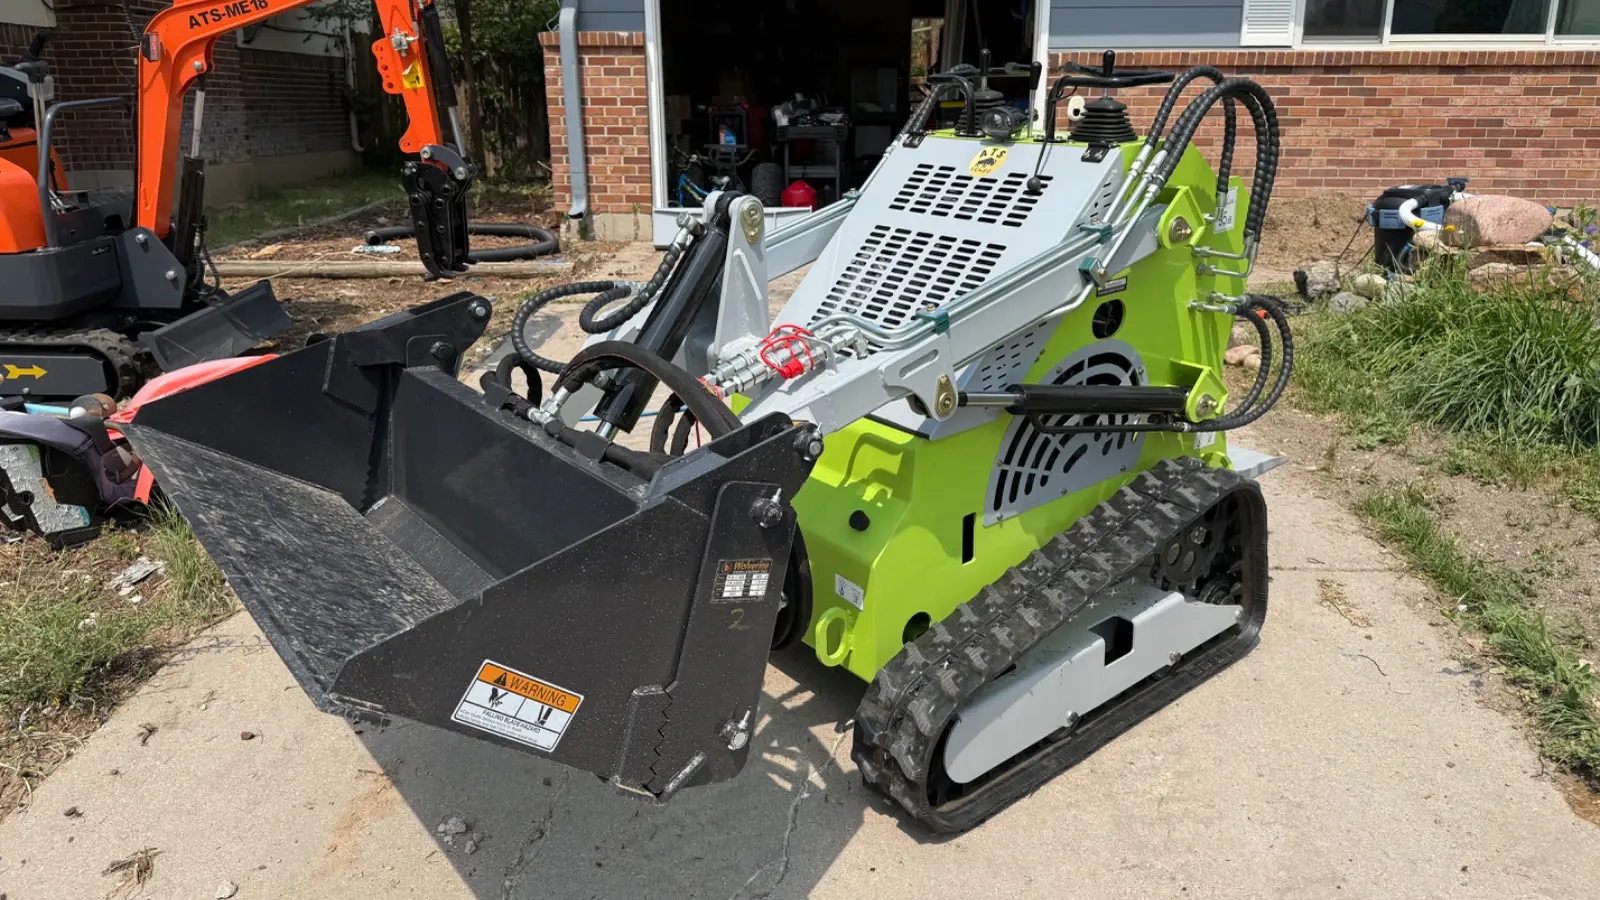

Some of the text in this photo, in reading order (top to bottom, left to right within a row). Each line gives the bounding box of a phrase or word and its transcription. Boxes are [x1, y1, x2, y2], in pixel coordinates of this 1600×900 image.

[188, 0, 269, 29] ATS-ME18
[979, 147, 1006, 158] ATS
[728, 607, 750, 629] 2
[510, 677, 567, 706] WARNING
[520, 721, 541, 734] HAZARD
